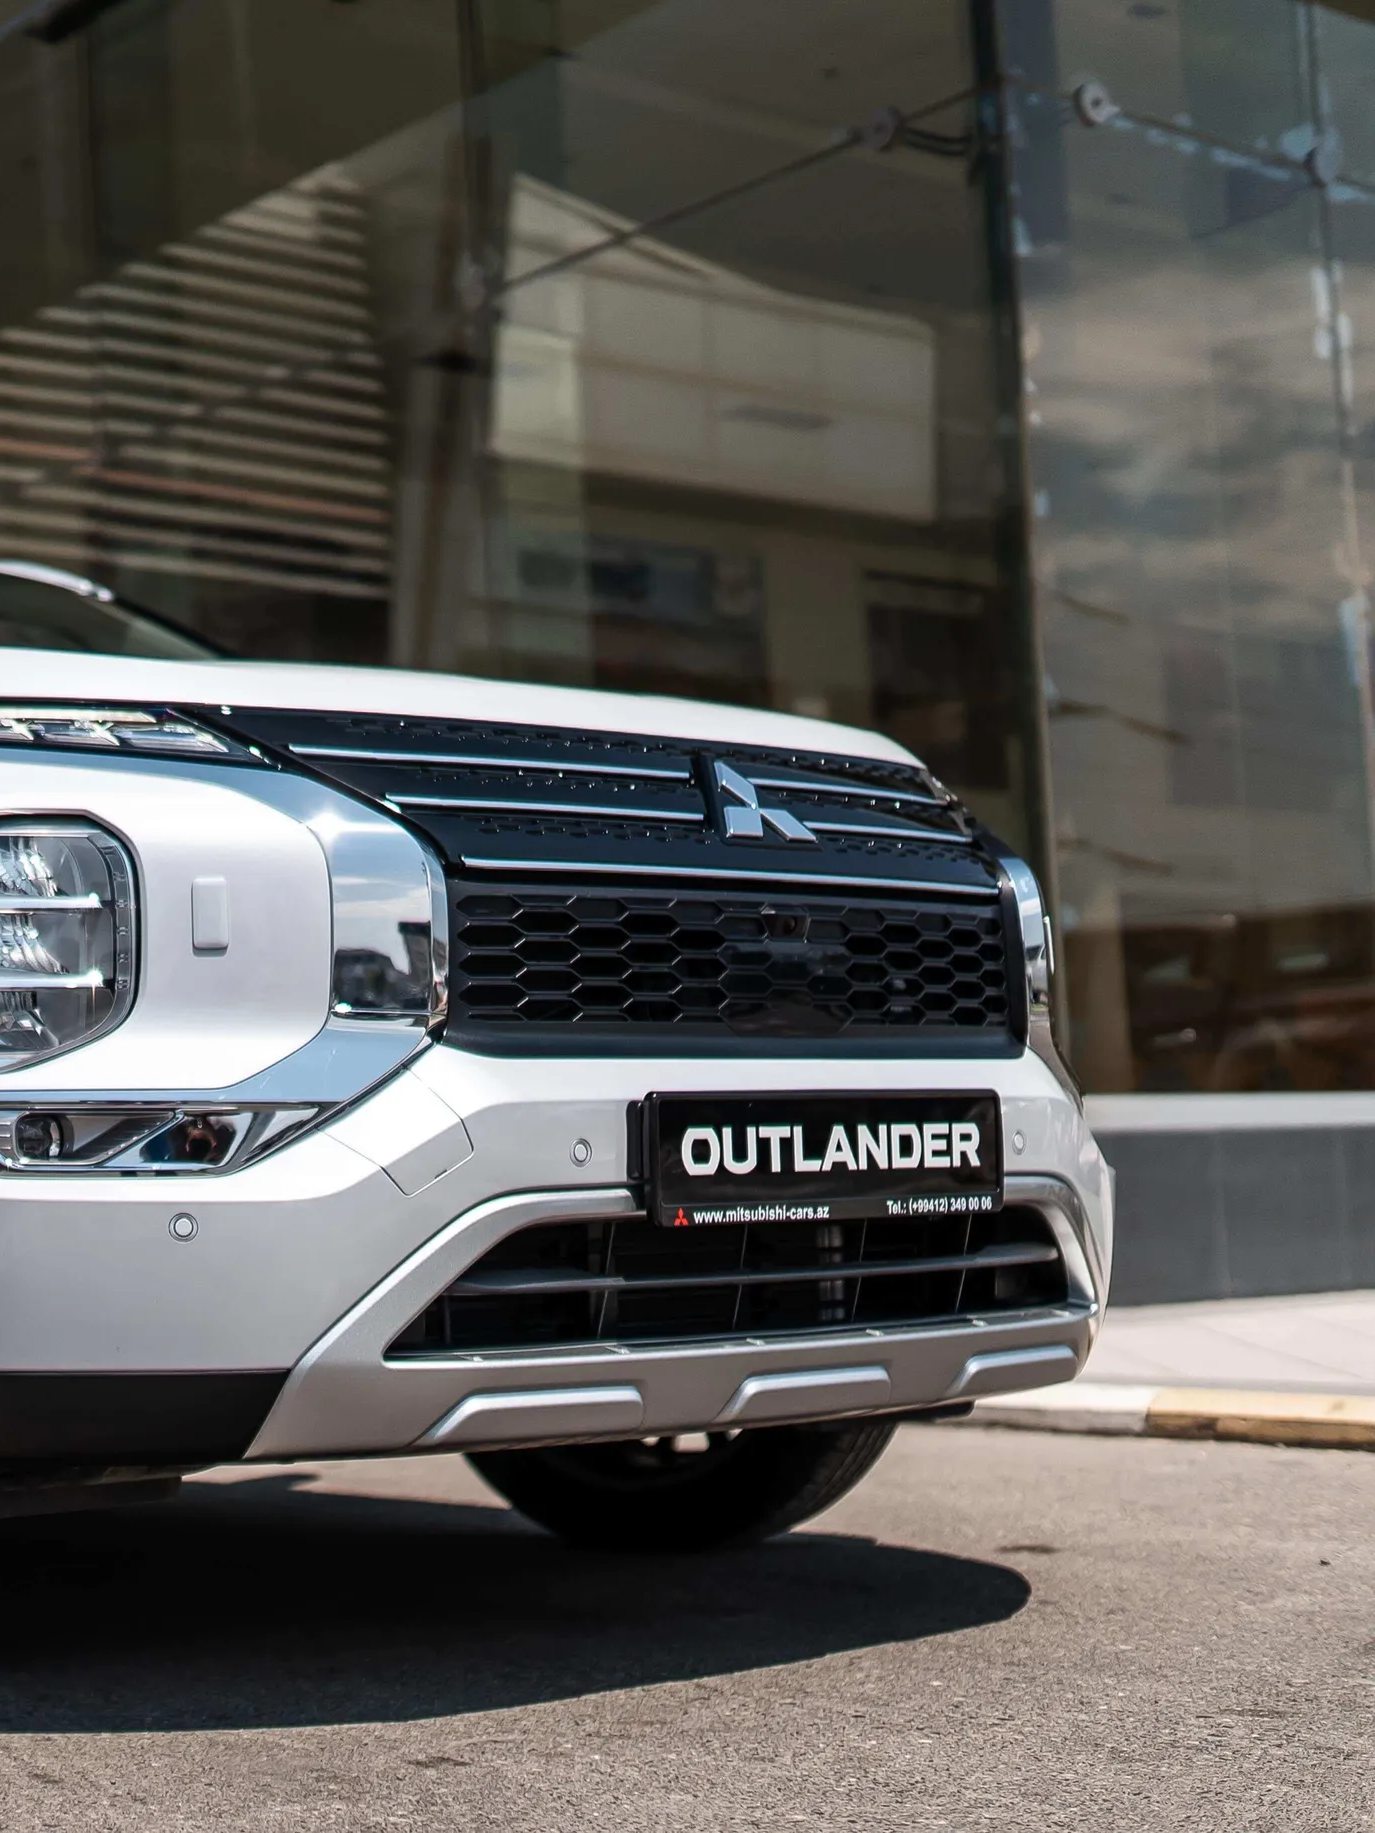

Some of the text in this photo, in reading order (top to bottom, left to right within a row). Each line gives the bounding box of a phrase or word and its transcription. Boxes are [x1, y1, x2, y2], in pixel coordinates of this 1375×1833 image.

[681, 1122, 981, 1176] OUTLANDER
[693, 1204, 830, 1224] www.mitsubishi-cars.az
[909, 1197, 949, 1215] (+99412)
[950, 1197, 966, 1211] 349
[968, 1197, 980, 1211] 00
